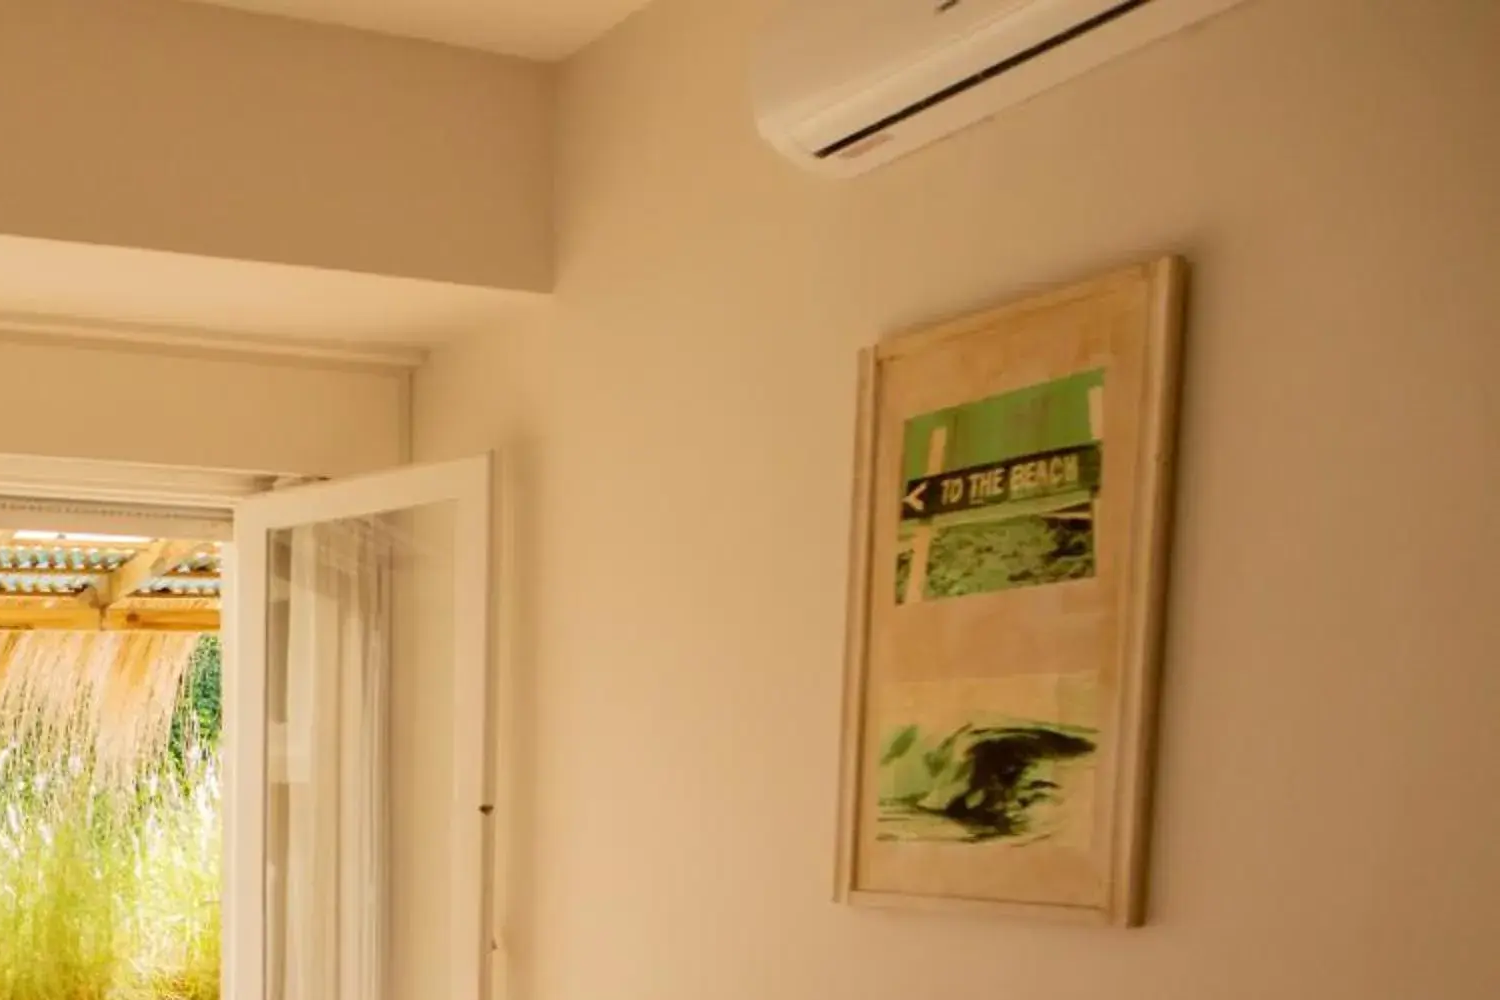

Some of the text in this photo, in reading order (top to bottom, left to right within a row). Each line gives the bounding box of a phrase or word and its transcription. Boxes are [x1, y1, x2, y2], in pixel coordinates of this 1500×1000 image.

[940, 453, 1079, 505] TO THE BEACH
